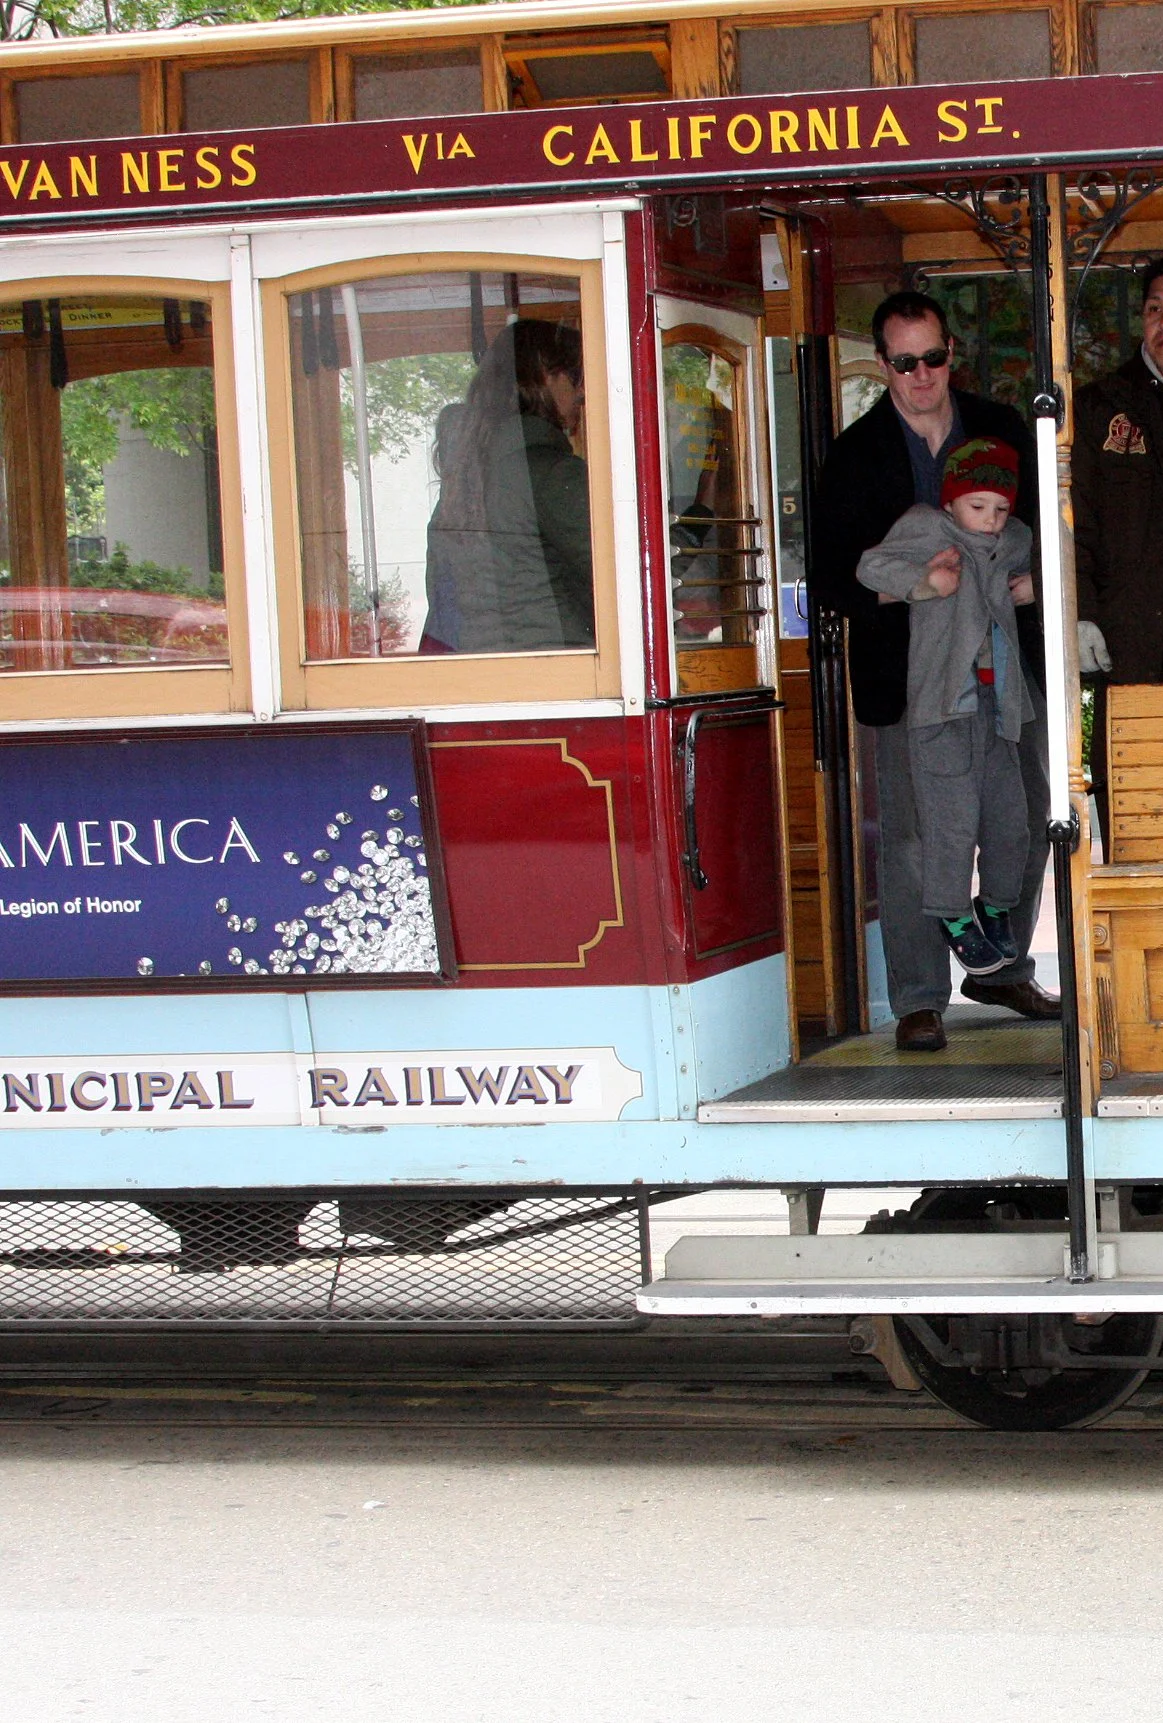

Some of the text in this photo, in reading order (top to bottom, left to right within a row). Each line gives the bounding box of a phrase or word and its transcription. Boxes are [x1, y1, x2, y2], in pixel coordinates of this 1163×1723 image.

[0, 155, 99, 200] VAN
[121, 144, 257, 194] NESS
[401, 132, 476, 175] VIA
[543, 104, 910, 166] CALIFORNIA
[0, 896, 142, 918] Legion of Honor
[307, 1064, 585, 1108] RAILWAY
